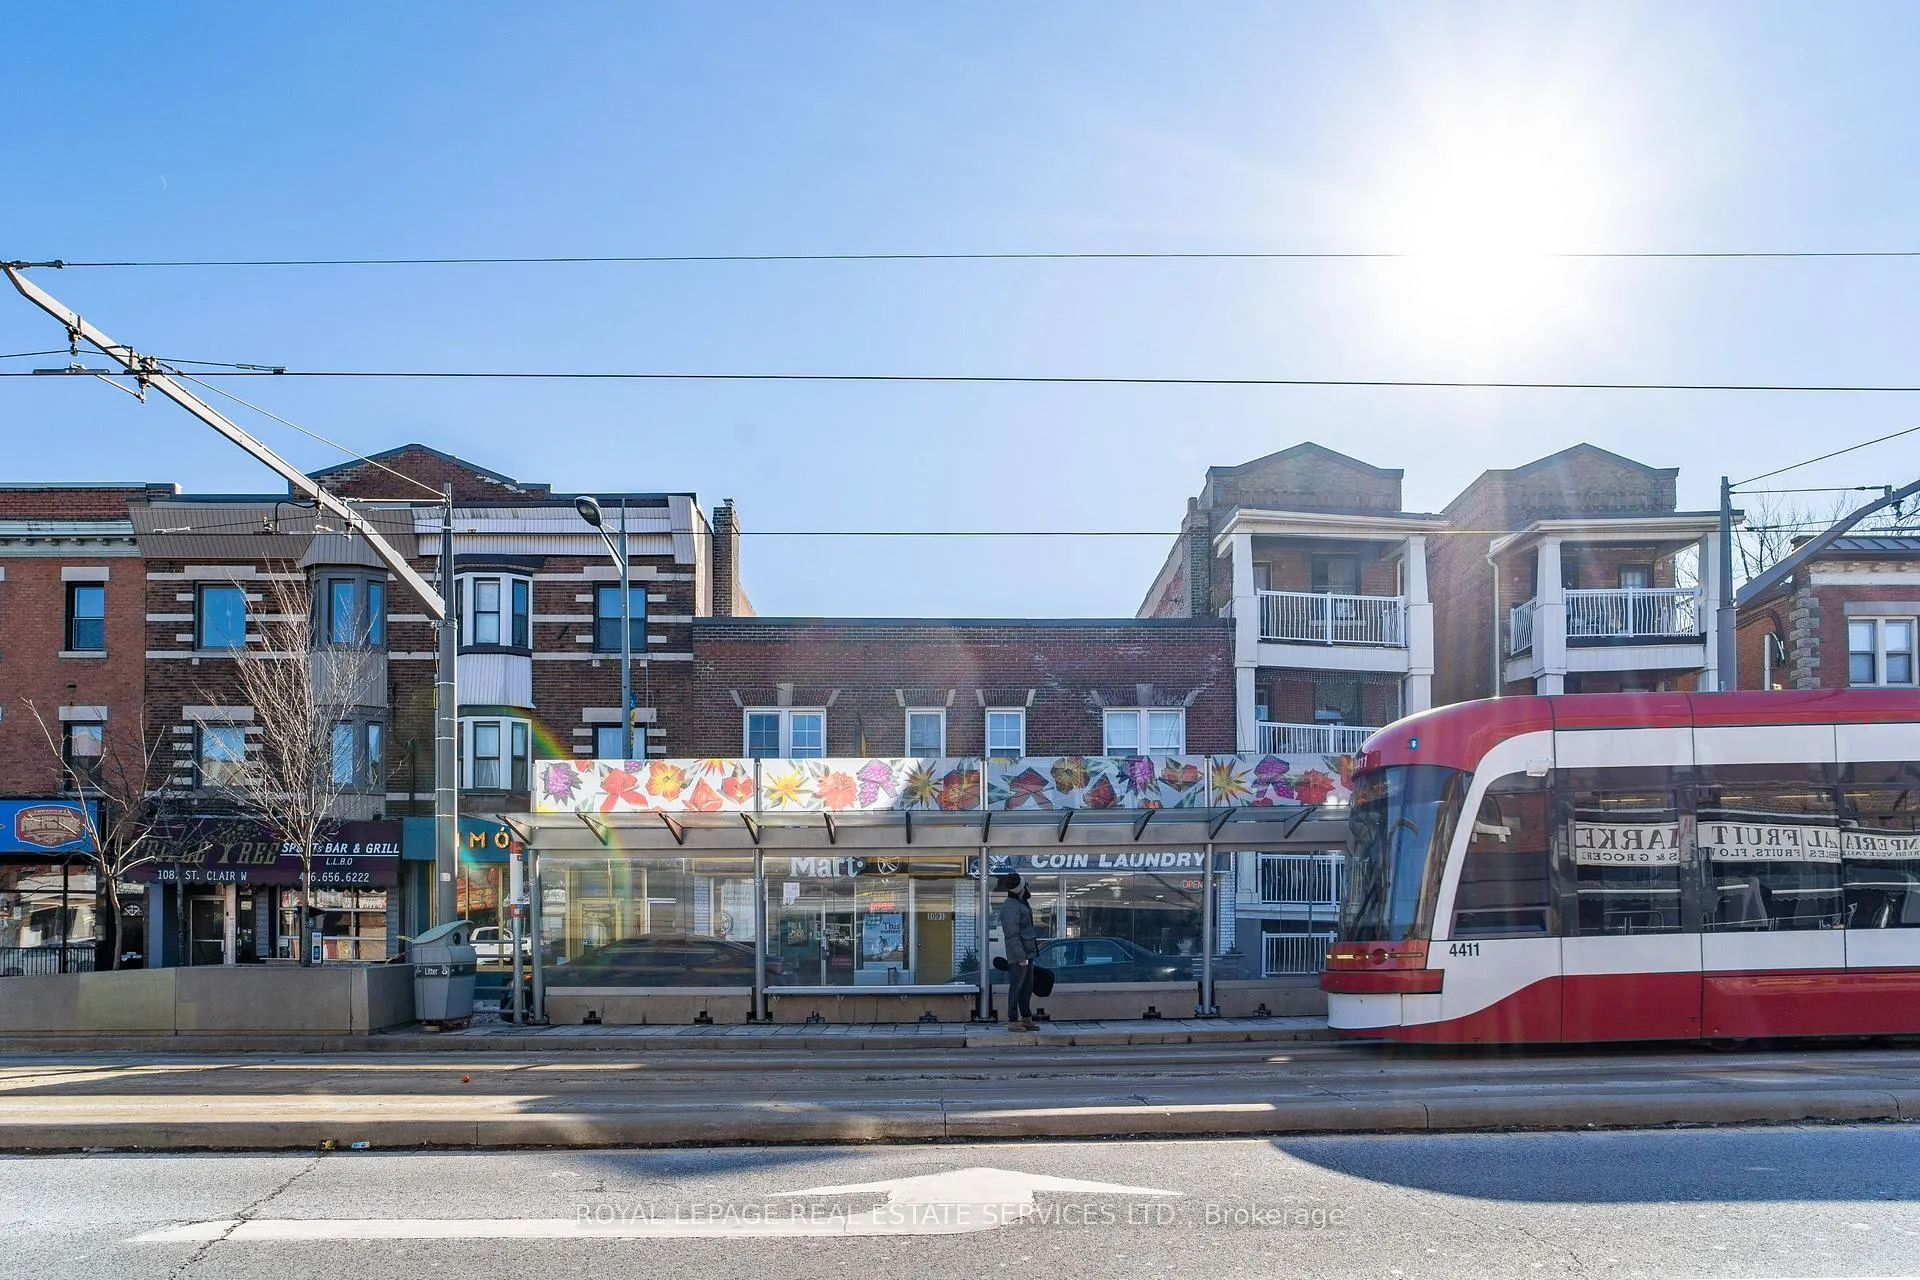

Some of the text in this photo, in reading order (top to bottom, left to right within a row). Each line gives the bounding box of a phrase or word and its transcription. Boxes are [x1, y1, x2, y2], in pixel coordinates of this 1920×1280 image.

[325, 842, 348, 854] BAR
[353, 842, 361, 854] &
[365, 843, 400, 854] GRILL
[1031, 852, 1205, 868] COIN LAUNDRY
[790, 856, 858, 878] Mart
[185, 870, 200, 880] ST.
[206, 871, 236, 881] CLAIR
[241, 871, 248, 881] W
[298, 871, 370, 882] 46.656.6222
[1182, 880, 1204, 889] OPEN
[1449, 942, 1480, 957] 4411
[424, 967, 438, 976] Litter
